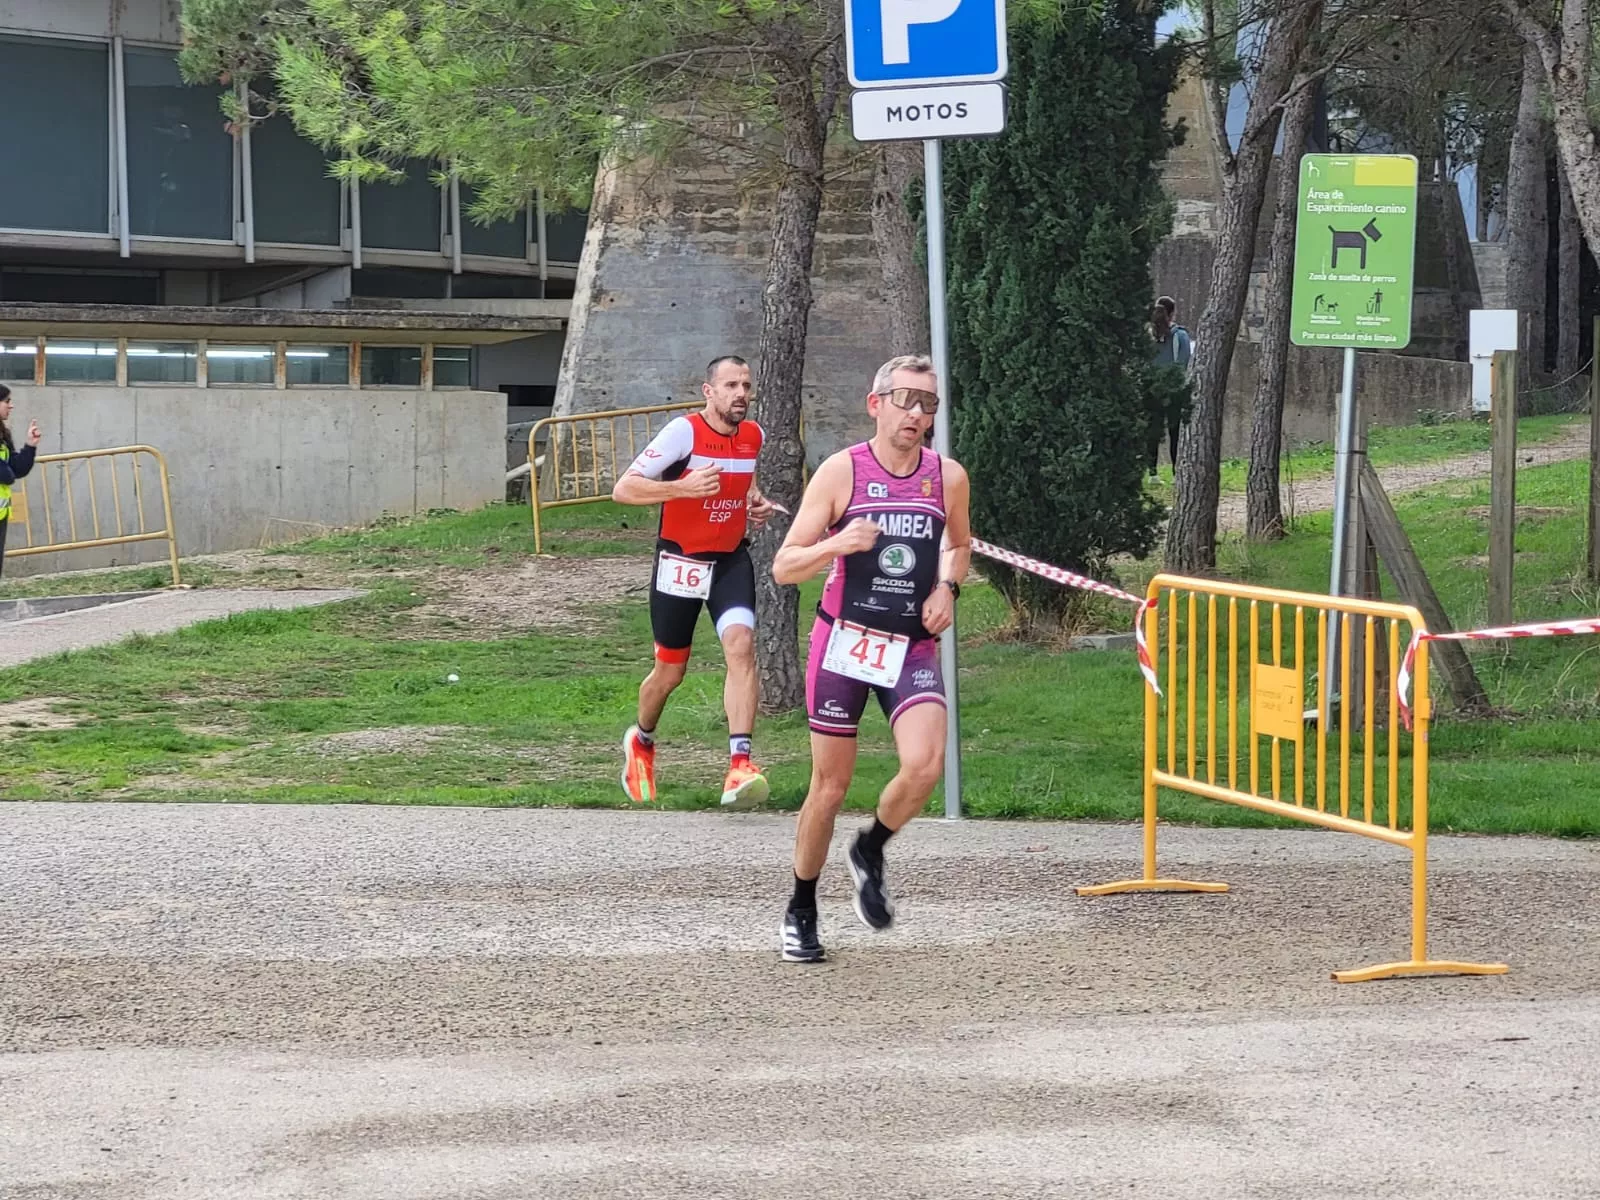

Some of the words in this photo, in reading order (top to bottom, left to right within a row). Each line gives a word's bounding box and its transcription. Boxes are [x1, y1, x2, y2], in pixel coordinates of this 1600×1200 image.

[880, 0, 962, 65] P
[886, 102, 968, 123] MOTOS
[1307, 187, 1330, 200] Área
[1331, 189, 1344, 200] de
[1306, 202, 1373, 215] Esparcimiento
[1375, 203, 1407, 214] canino
[1308, 272, 1327, 281] Zona
[1328, 273, 1338, 281] de
[1362, 274, 1371, 282] de
[1372, 275, 1397, 284] perros
[1302, 331, 1315, 340] Por
[1331, 332, 1356, 341] ciudad
[1373, 334, 1397, 343] limpia
[709, 511, 732, 523] ESP
[672, 564, 701, 588] 16
[848, 637, 887, 671] 41
